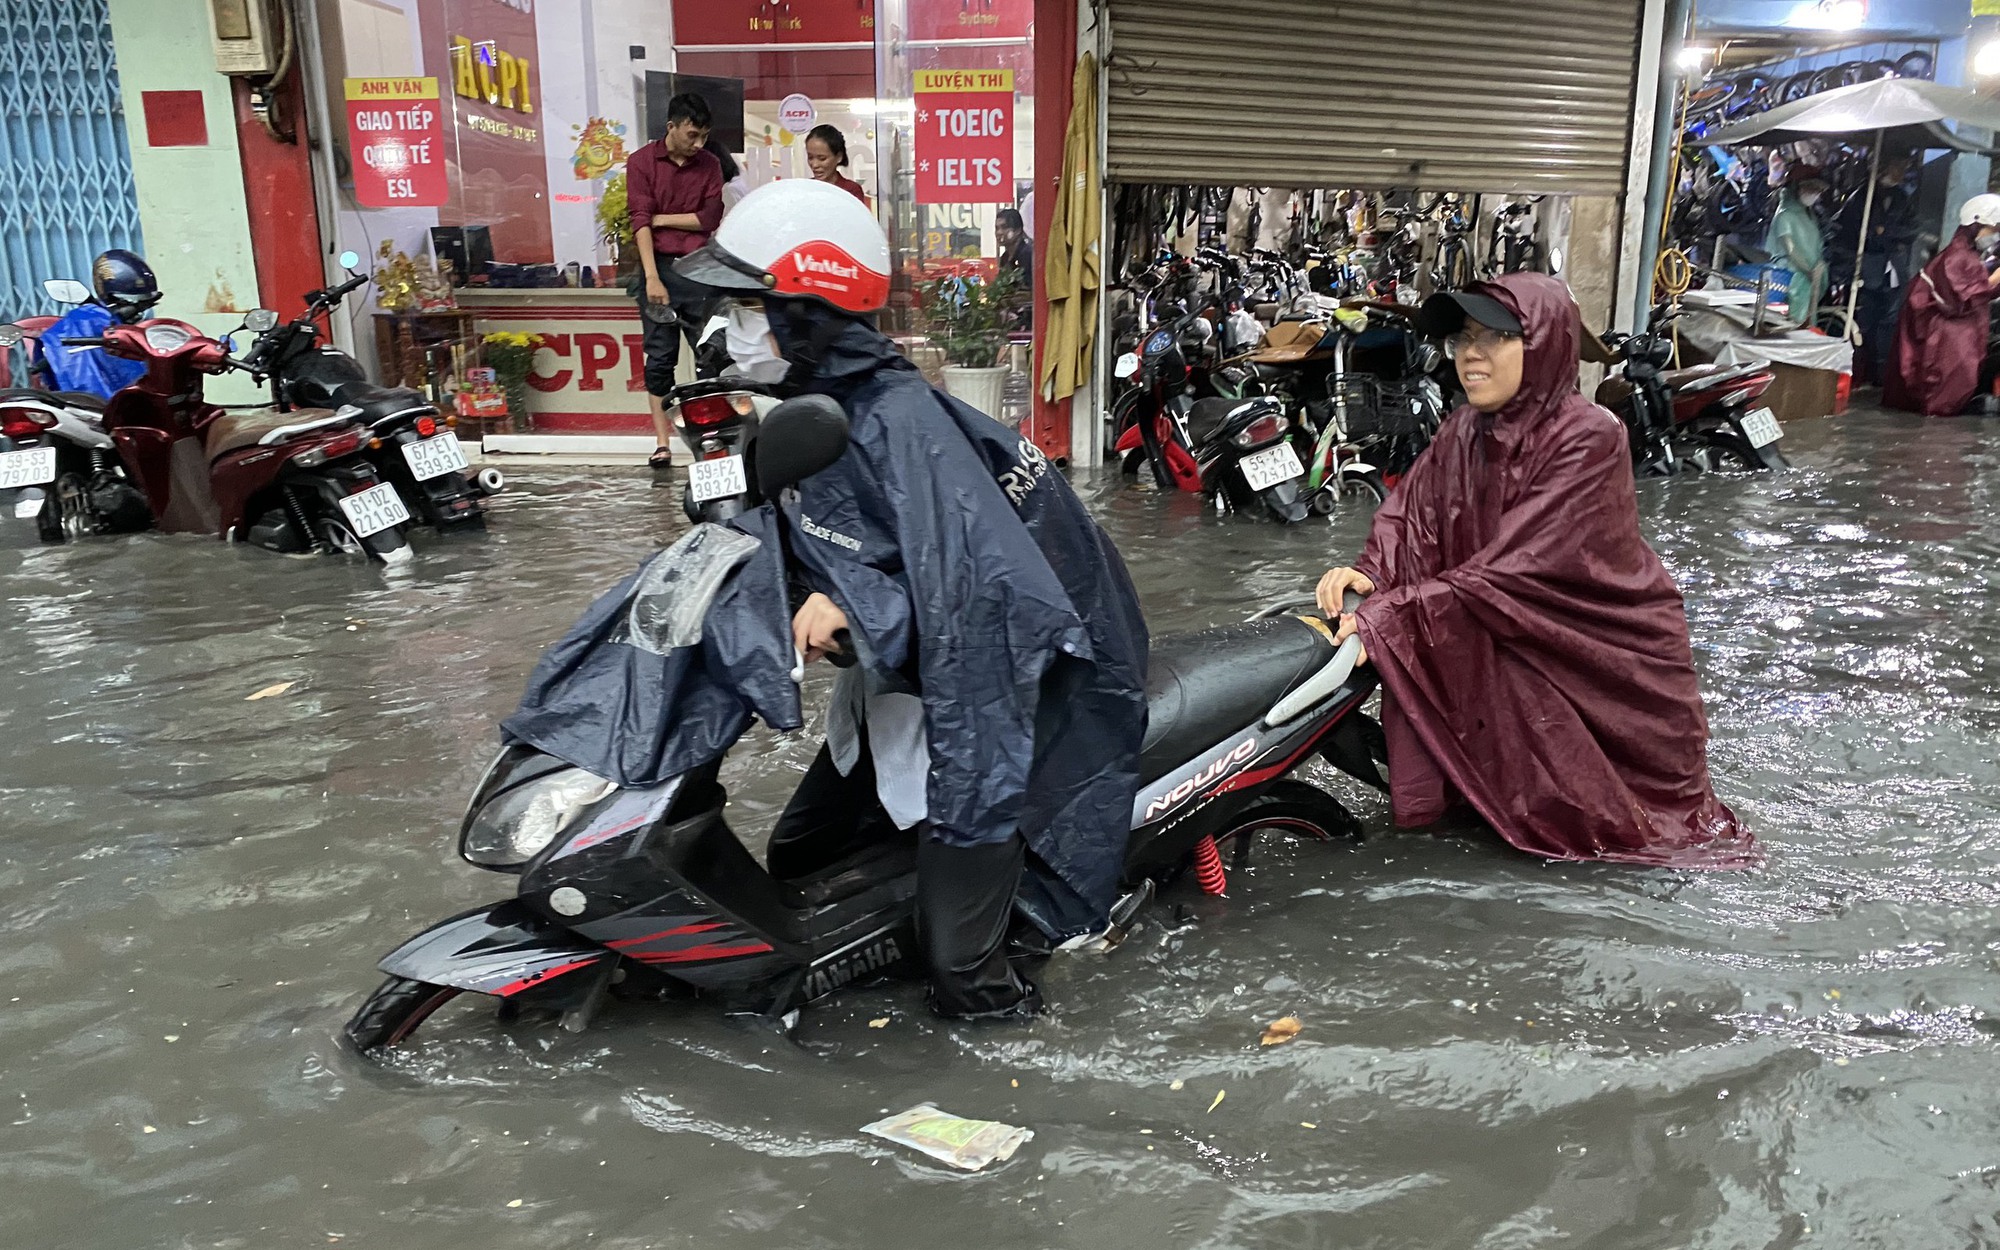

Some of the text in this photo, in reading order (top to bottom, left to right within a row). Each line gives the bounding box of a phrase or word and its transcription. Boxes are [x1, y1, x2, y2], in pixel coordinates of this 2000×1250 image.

[749, 17, 774, 31] Nw
[958, 13, 1000, 27] Sydney
[361, 79, 422, 94] ANH VĂN
[454, 35, 534, 113] ACPI
[925, 71, 1003, 90] LUYỆN THI
[356, 103, 434, 131] GIAO TIẾP
[935, 108, 1004, 138] TOEIC
[409, 137, 432, 164] TẾ
[938, 157, 1002, 186] IELTS
[387, 178, 418, 198] ESL
[794, 252, 859, 280] VinMart
[7, 451, 46, 469] 59-S3
[412, 437, 451, 461] 67-E1
[3, 466, 50, 486] 797.03
[415, 452, 462, 477] 539.31
[696, 459, 735, 481] 59-F2
[695, 475, 741, 499] 393.24
[351, 488, 390, 514] 61-D2
[355, 503, 404, 534] 221.90
[1145, 738, 1255, 819] NOUVO
[802, 937, 902, 1000] YAMAHA
